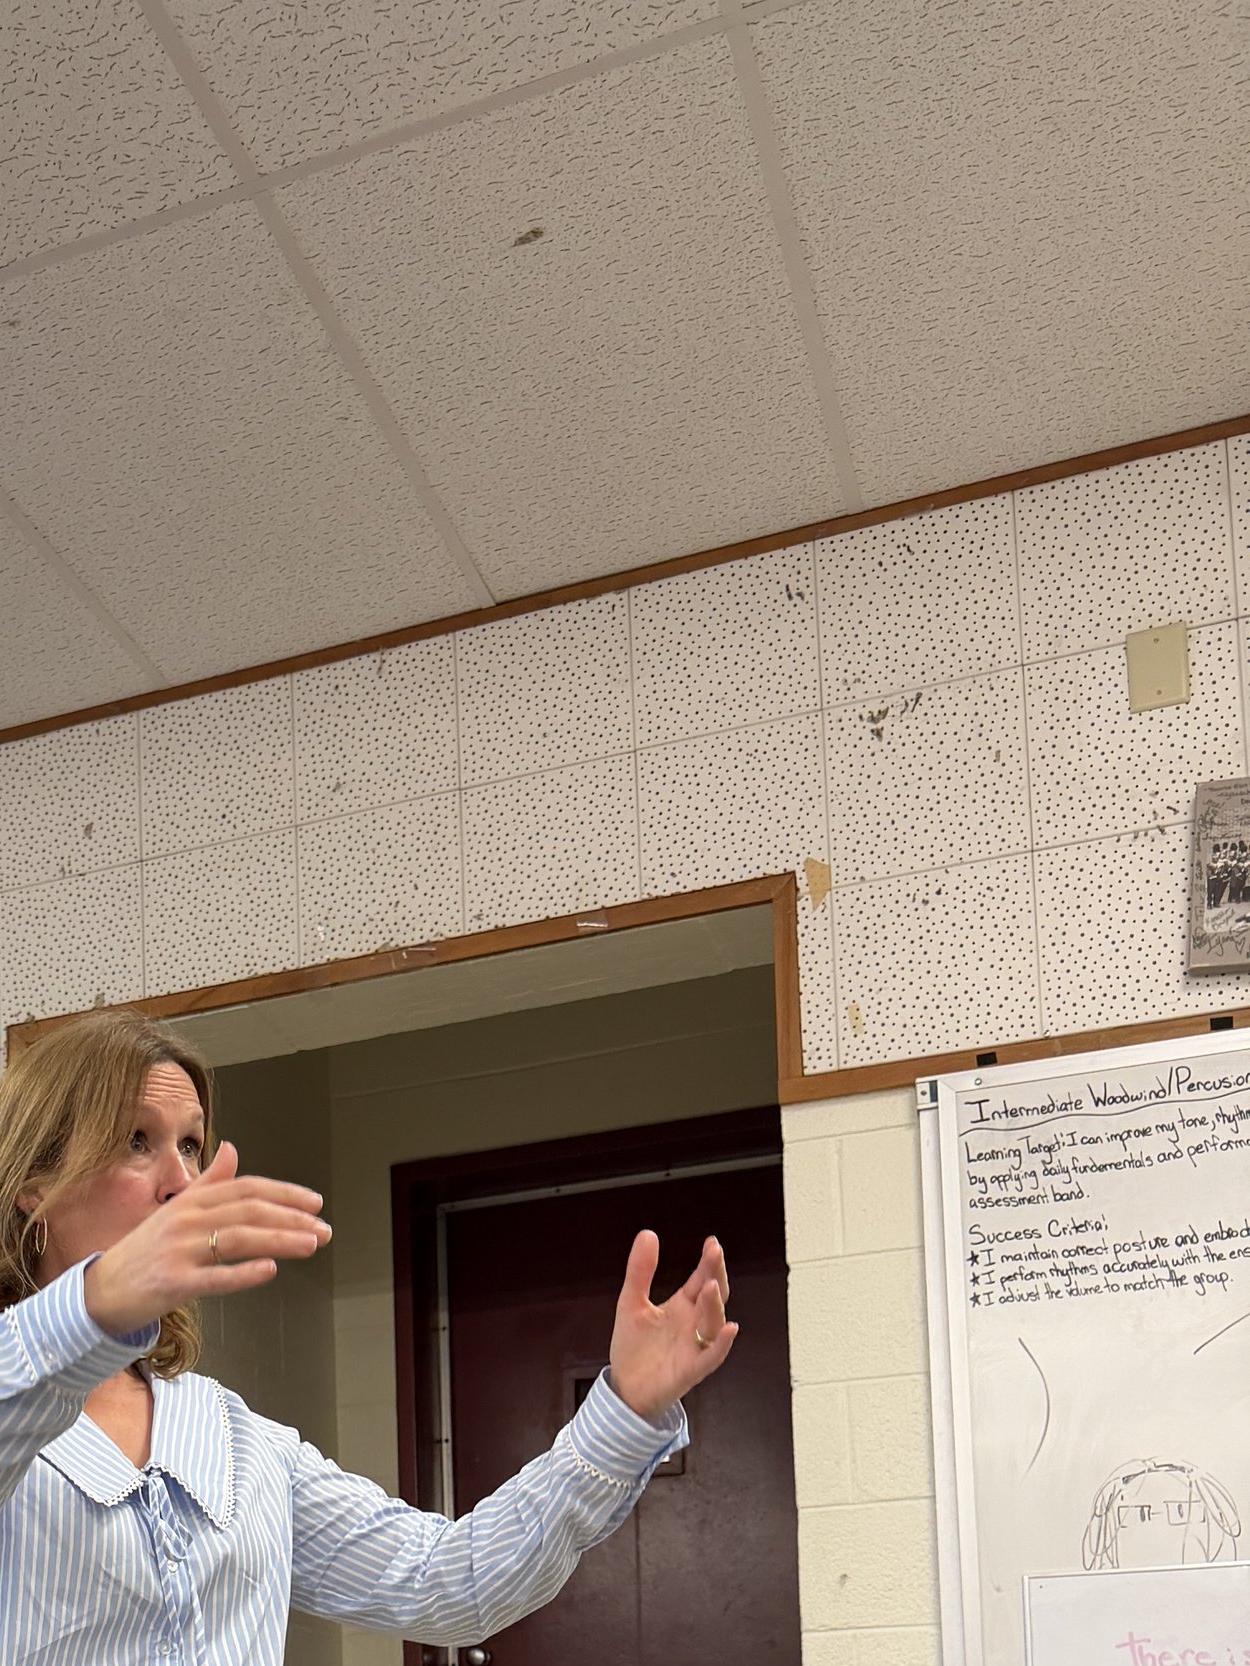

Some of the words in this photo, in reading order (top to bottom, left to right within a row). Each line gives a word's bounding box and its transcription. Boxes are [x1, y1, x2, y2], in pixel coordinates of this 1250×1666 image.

[964, 1092, 1083, 1124] Intermediate
[965, 1141, 1022, 1171] Learning
[1066, 1131, 1078, 1147] I
[1080, 1135, 1103, 1145] can
[1105, 1126, 1152, 1152] improve
[1155, 1122, 1179, 1144] my
[1178, 1107, 1216, 1131] tone,
[967, 1170, 988, 1194] by
[990, 1168, 1039, 1192] applying
[1041, 1159, 1072, 1184] daily
[1157, 1143, 1184, 1163] and
[969, 1187, 1049, 1209] assessment
[968, 1223, 1042, 1245] Success
[1000, 1243, 1059, 1263] maintain
[1061, 1237, 1108, 1258] correct
[1113, 1230, 1170, 1264] posture
[1174, 1224, 1199, 1247] and
[998, 1284, 1040, 1304] adjust
[1044, 1282, 1063, 1300] the
[1065, 1280, 1103, 1298] volume
[1103, 1276, 1120, 1293] to
[1124, 1273, 1165, 1292] match
[1168, 1269, 1188, 1288] the
[1000, 1265, 1047, 1292] perform
[1049, 1261, 1098, 1287] rhythms
[1103, 1253, 1172, 1281] accurately
[1171, 1248, 1201, 1267] with
[1203, 1245, 1227, 1263] the
